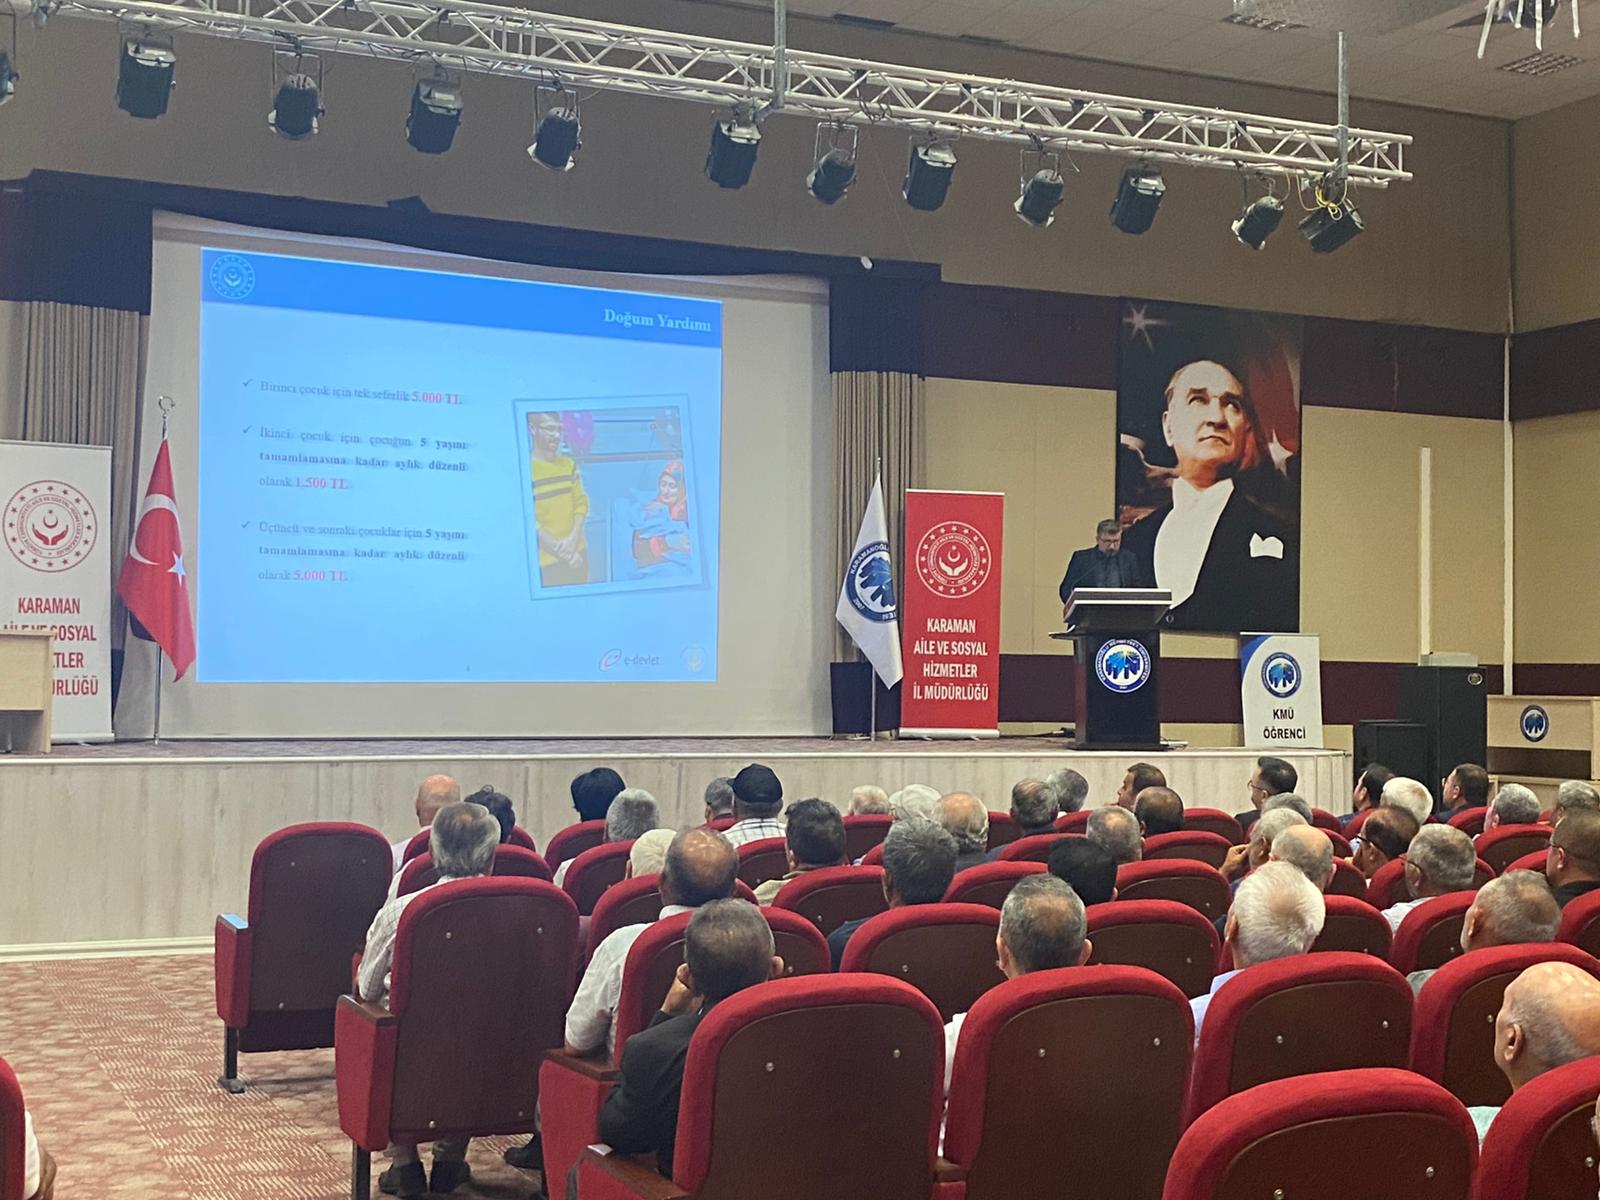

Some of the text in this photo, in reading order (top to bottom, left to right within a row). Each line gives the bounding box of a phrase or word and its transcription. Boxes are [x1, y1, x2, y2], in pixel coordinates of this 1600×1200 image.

[604, 309, 711, 332] Doğum Yardımı
[354, 388, 370, 399] tek
[411, 391, 443, 404] 5.000
[300, 431, 332, 442] çocuk
[340, 431, 360, 444] için
[420, 437, 427, 447] 5
[436, 439, 467, 451] yaşını
[260, 452, 467, 472] tamamlamasına kadar aylık düzenli
[259, 477, 295, 488] olarak
[302, 526, 315, 534] ve
[425, 528, 432, 538] 5
[434, 530, 465, 542] yaşını
[259, 546, 345, 558] tamamlamasına
[354, 548, 385, 559] kadar
[427, 550, 465, 561] düzenli
[258, 570, 290, 581] olarak
[292, 570, 325, 582] 5.000
[18, 597, 80, 614] KARAMAN
[927, 618, 976, 633] KARAMAN
[913, 637, 988, 656] AİLE VE SOSYAL
[923, 660, 978, 678] HİZMETLER
[913, 681, 989, 701] İL MÜDÜRLÜĞÜ
[1273, 706, 1294, 720] KMÜ
[1263, 726, 1306, 739] ÖĞRENCİ
